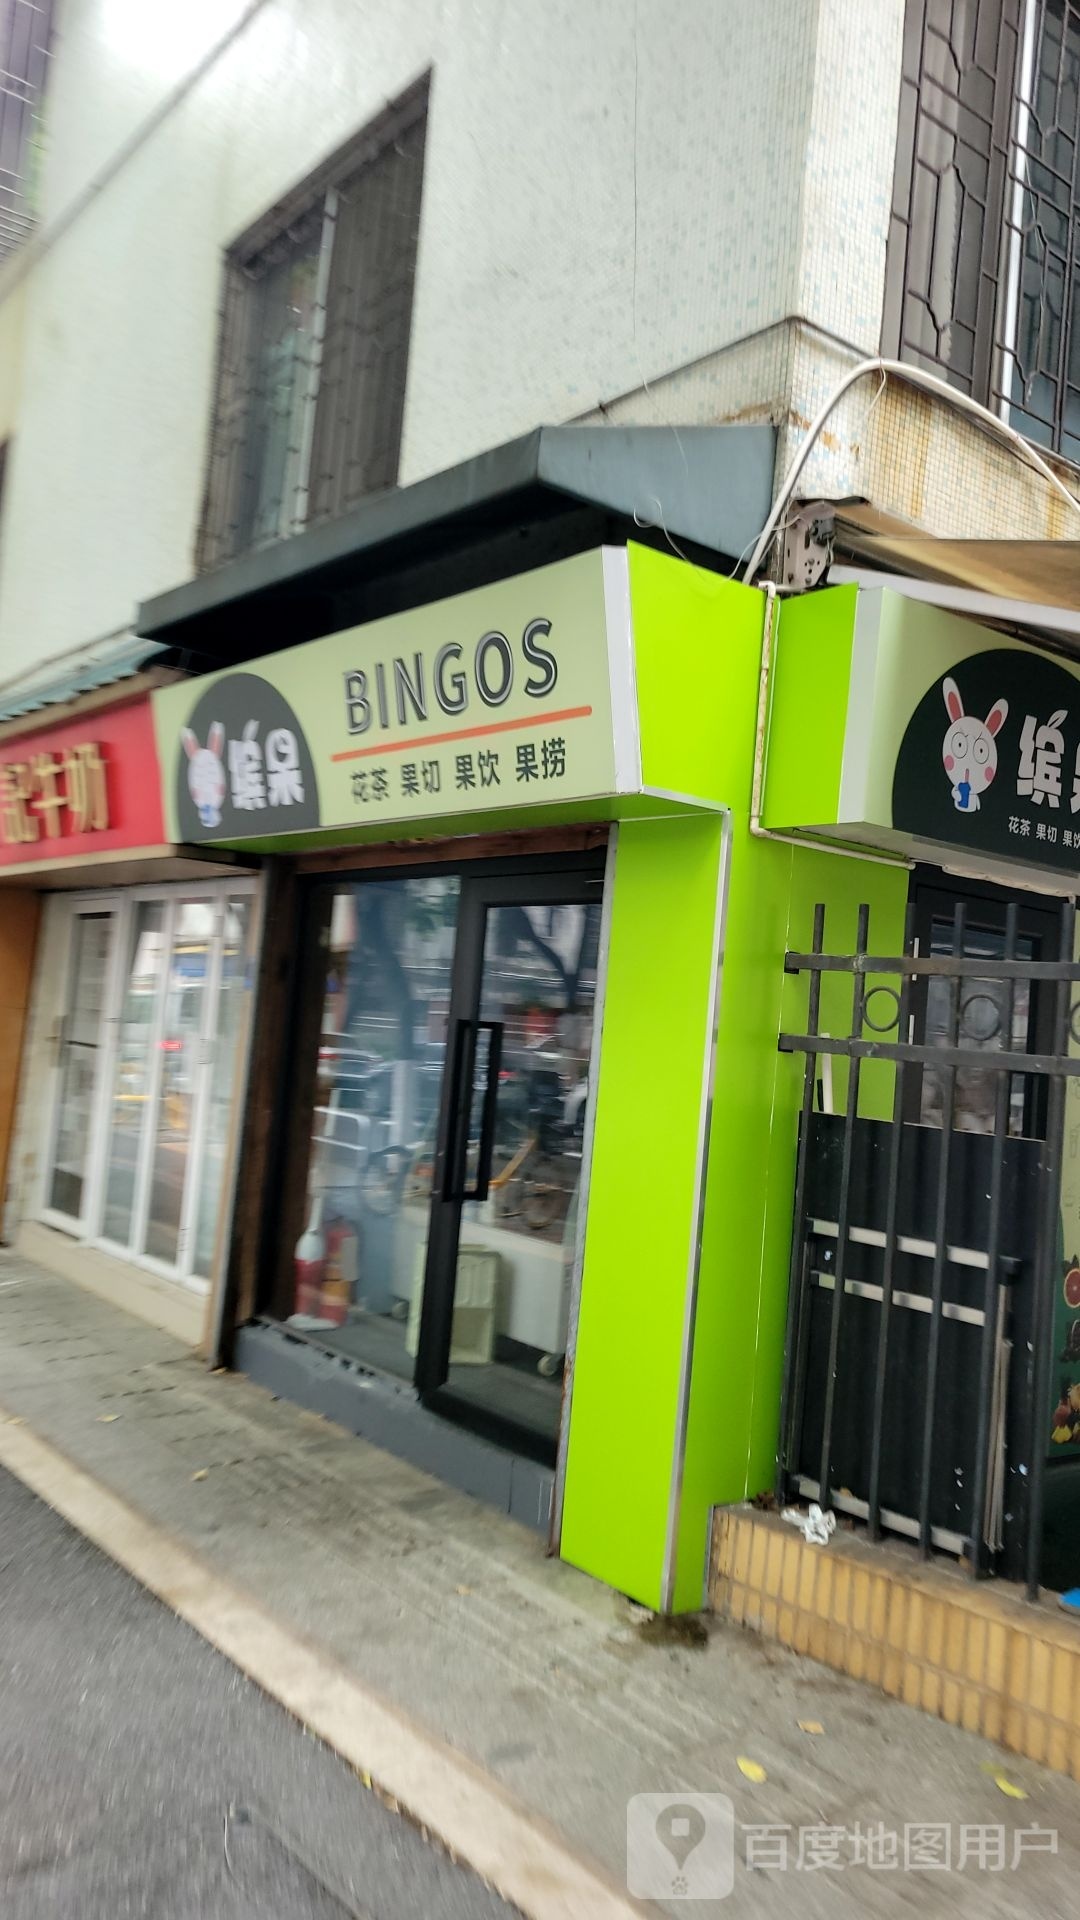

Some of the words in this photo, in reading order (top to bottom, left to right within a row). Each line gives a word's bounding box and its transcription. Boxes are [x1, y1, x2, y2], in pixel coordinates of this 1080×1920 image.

[342, 617, 558, 735] BINGOS
[351, 766, 391, 804] 花茶
[401, 760, 441, 797] 果切
[455, 749, 501, 791] 果饮
[515, 737, 567, 783] 果捞
[1008, 815, 1031, 836] 花茶
[1036, 823, 1058, 843] 果切
